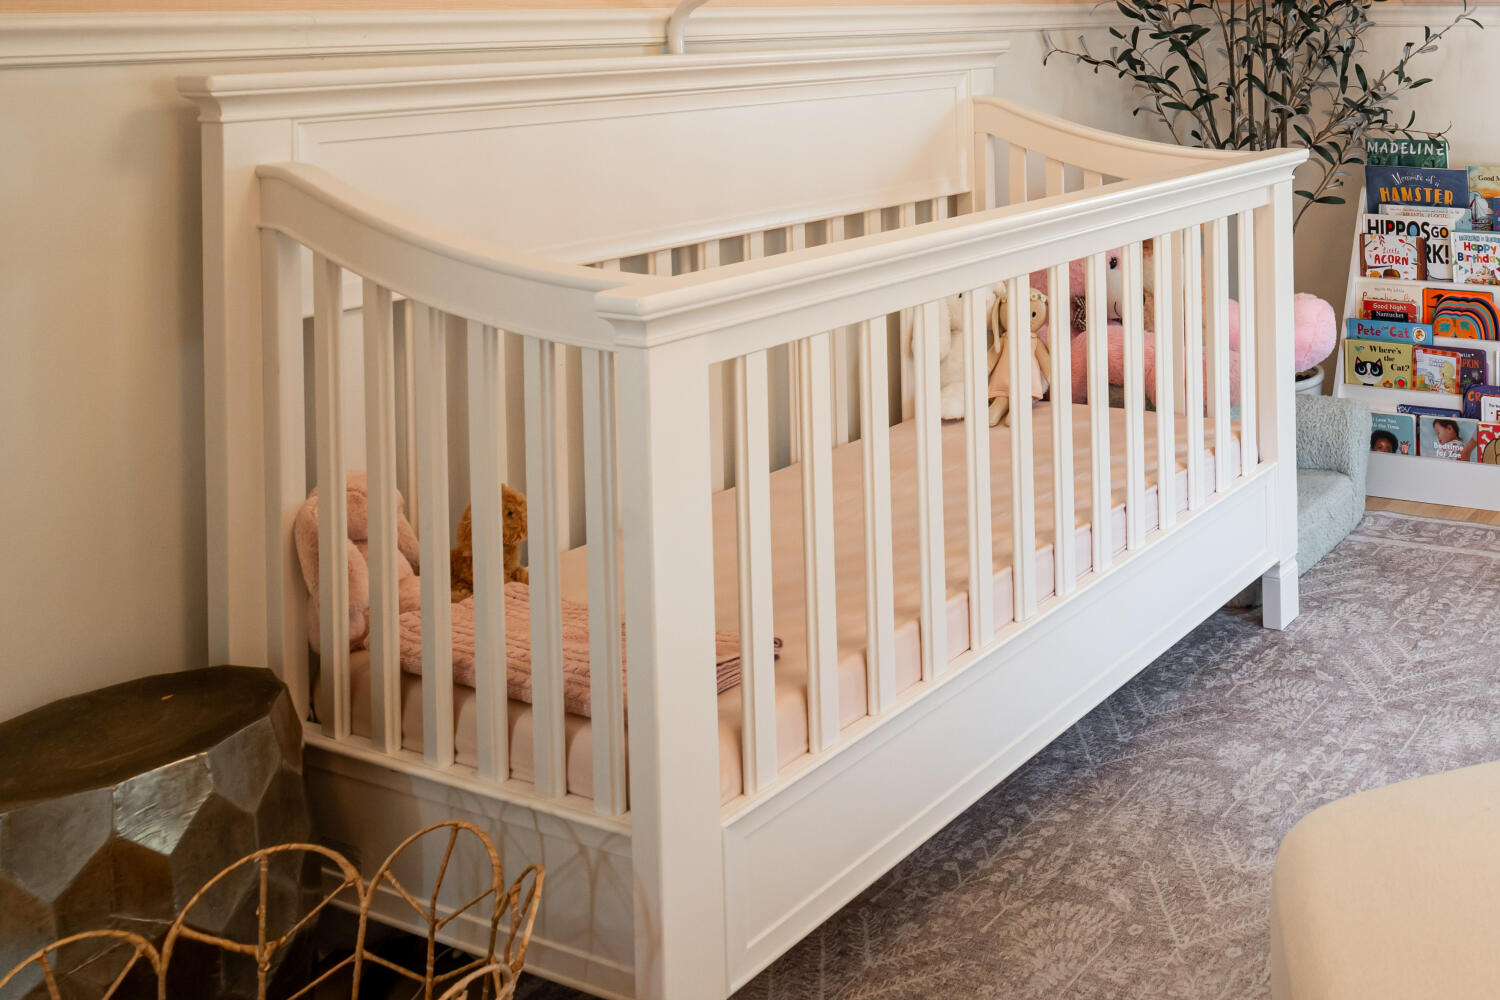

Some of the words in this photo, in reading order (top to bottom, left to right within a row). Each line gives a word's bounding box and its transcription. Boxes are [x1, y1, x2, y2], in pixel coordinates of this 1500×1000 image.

[1367, 141, 1445, 156] MADELINE
[1478, 174, 1495, 182] Good
[1379, 186, 1454, 205] HAMSTER
[1367, 218, 1431, 241] HIPPOS
[1431, 226, 1449, 239] GO
[1382, 246, 1400, 255] Little
[1463, 241, 1497, 255] Happy
[1374, 253, 1409, 266] ACORN
[1372, 302, 1388, 310] Good
[1376, 310, 1404, 319] Nantucket
[1357, 322, 1382, 337] Pete
[1389, 326, 1410, 339] Cat
[1368, 344, 1402, 355] Where's
[1383, 354, 1395, 362] the
[1390, 363, 1410, 372] Cat?
[1433, 441, 1464, 451] Bedtime
[1436, 449, 1446, 457] for
